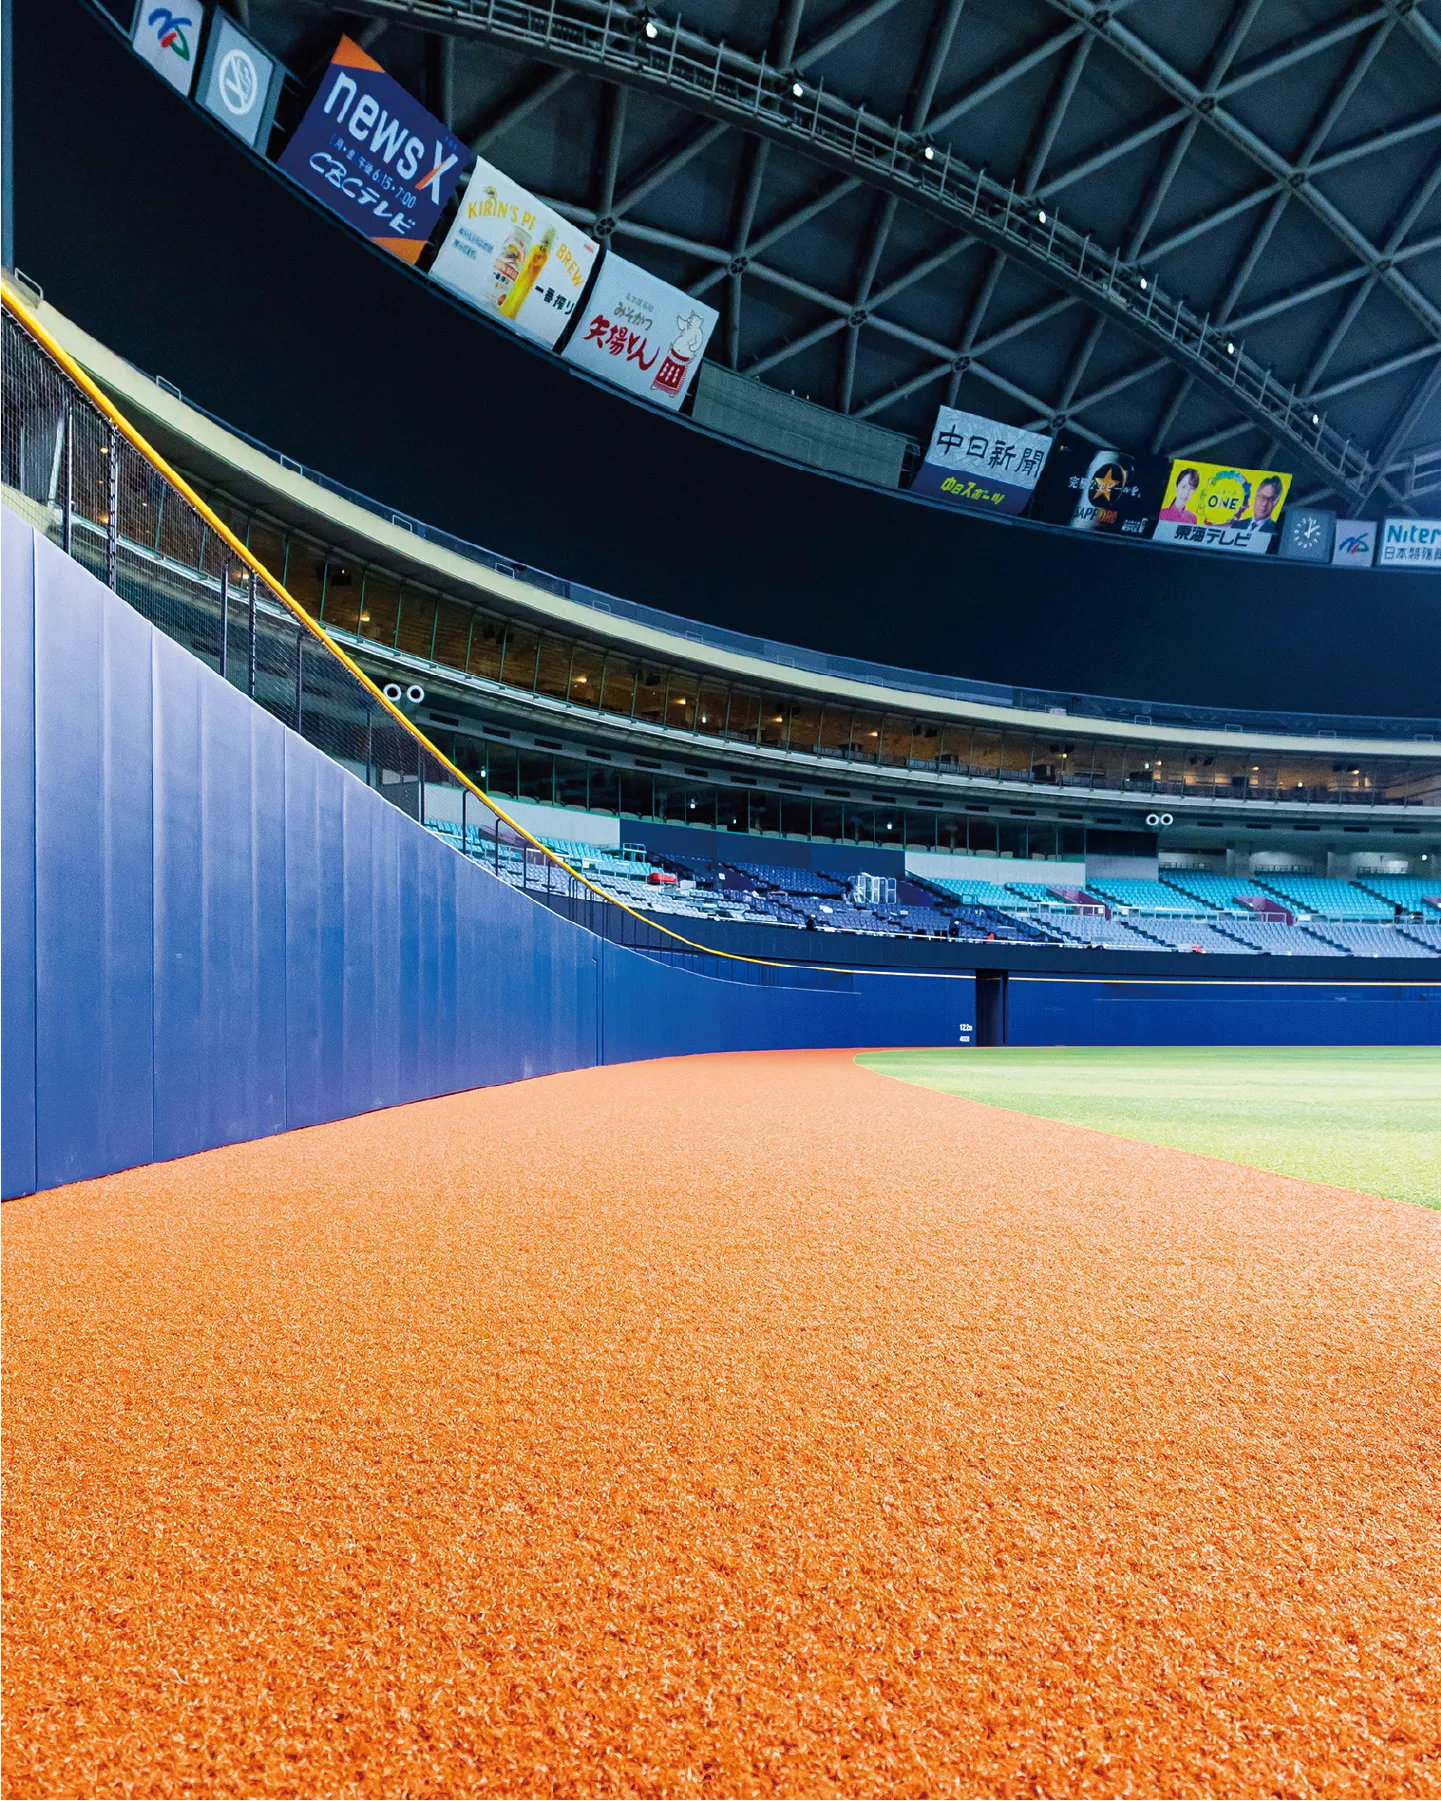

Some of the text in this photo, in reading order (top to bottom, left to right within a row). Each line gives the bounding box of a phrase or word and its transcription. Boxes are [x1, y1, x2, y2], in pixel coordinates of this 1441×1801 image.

[309, 151, 416, 235] CBCテレビ
[467, 199, 519, 223] KIRIN'S
[556, 242, 585, 287] BREW
[535, 285, 575, 315] 一番搾り
[583, 314, 661, 371] 矢場とん
[937, 423, 1045, 479] 中日新聞
[940, 476, 1006, 505] 中日スポーツ
[1208, 494, 1240, 511] ONE
[1174, 524, 1253, 547] 東海テレビ
